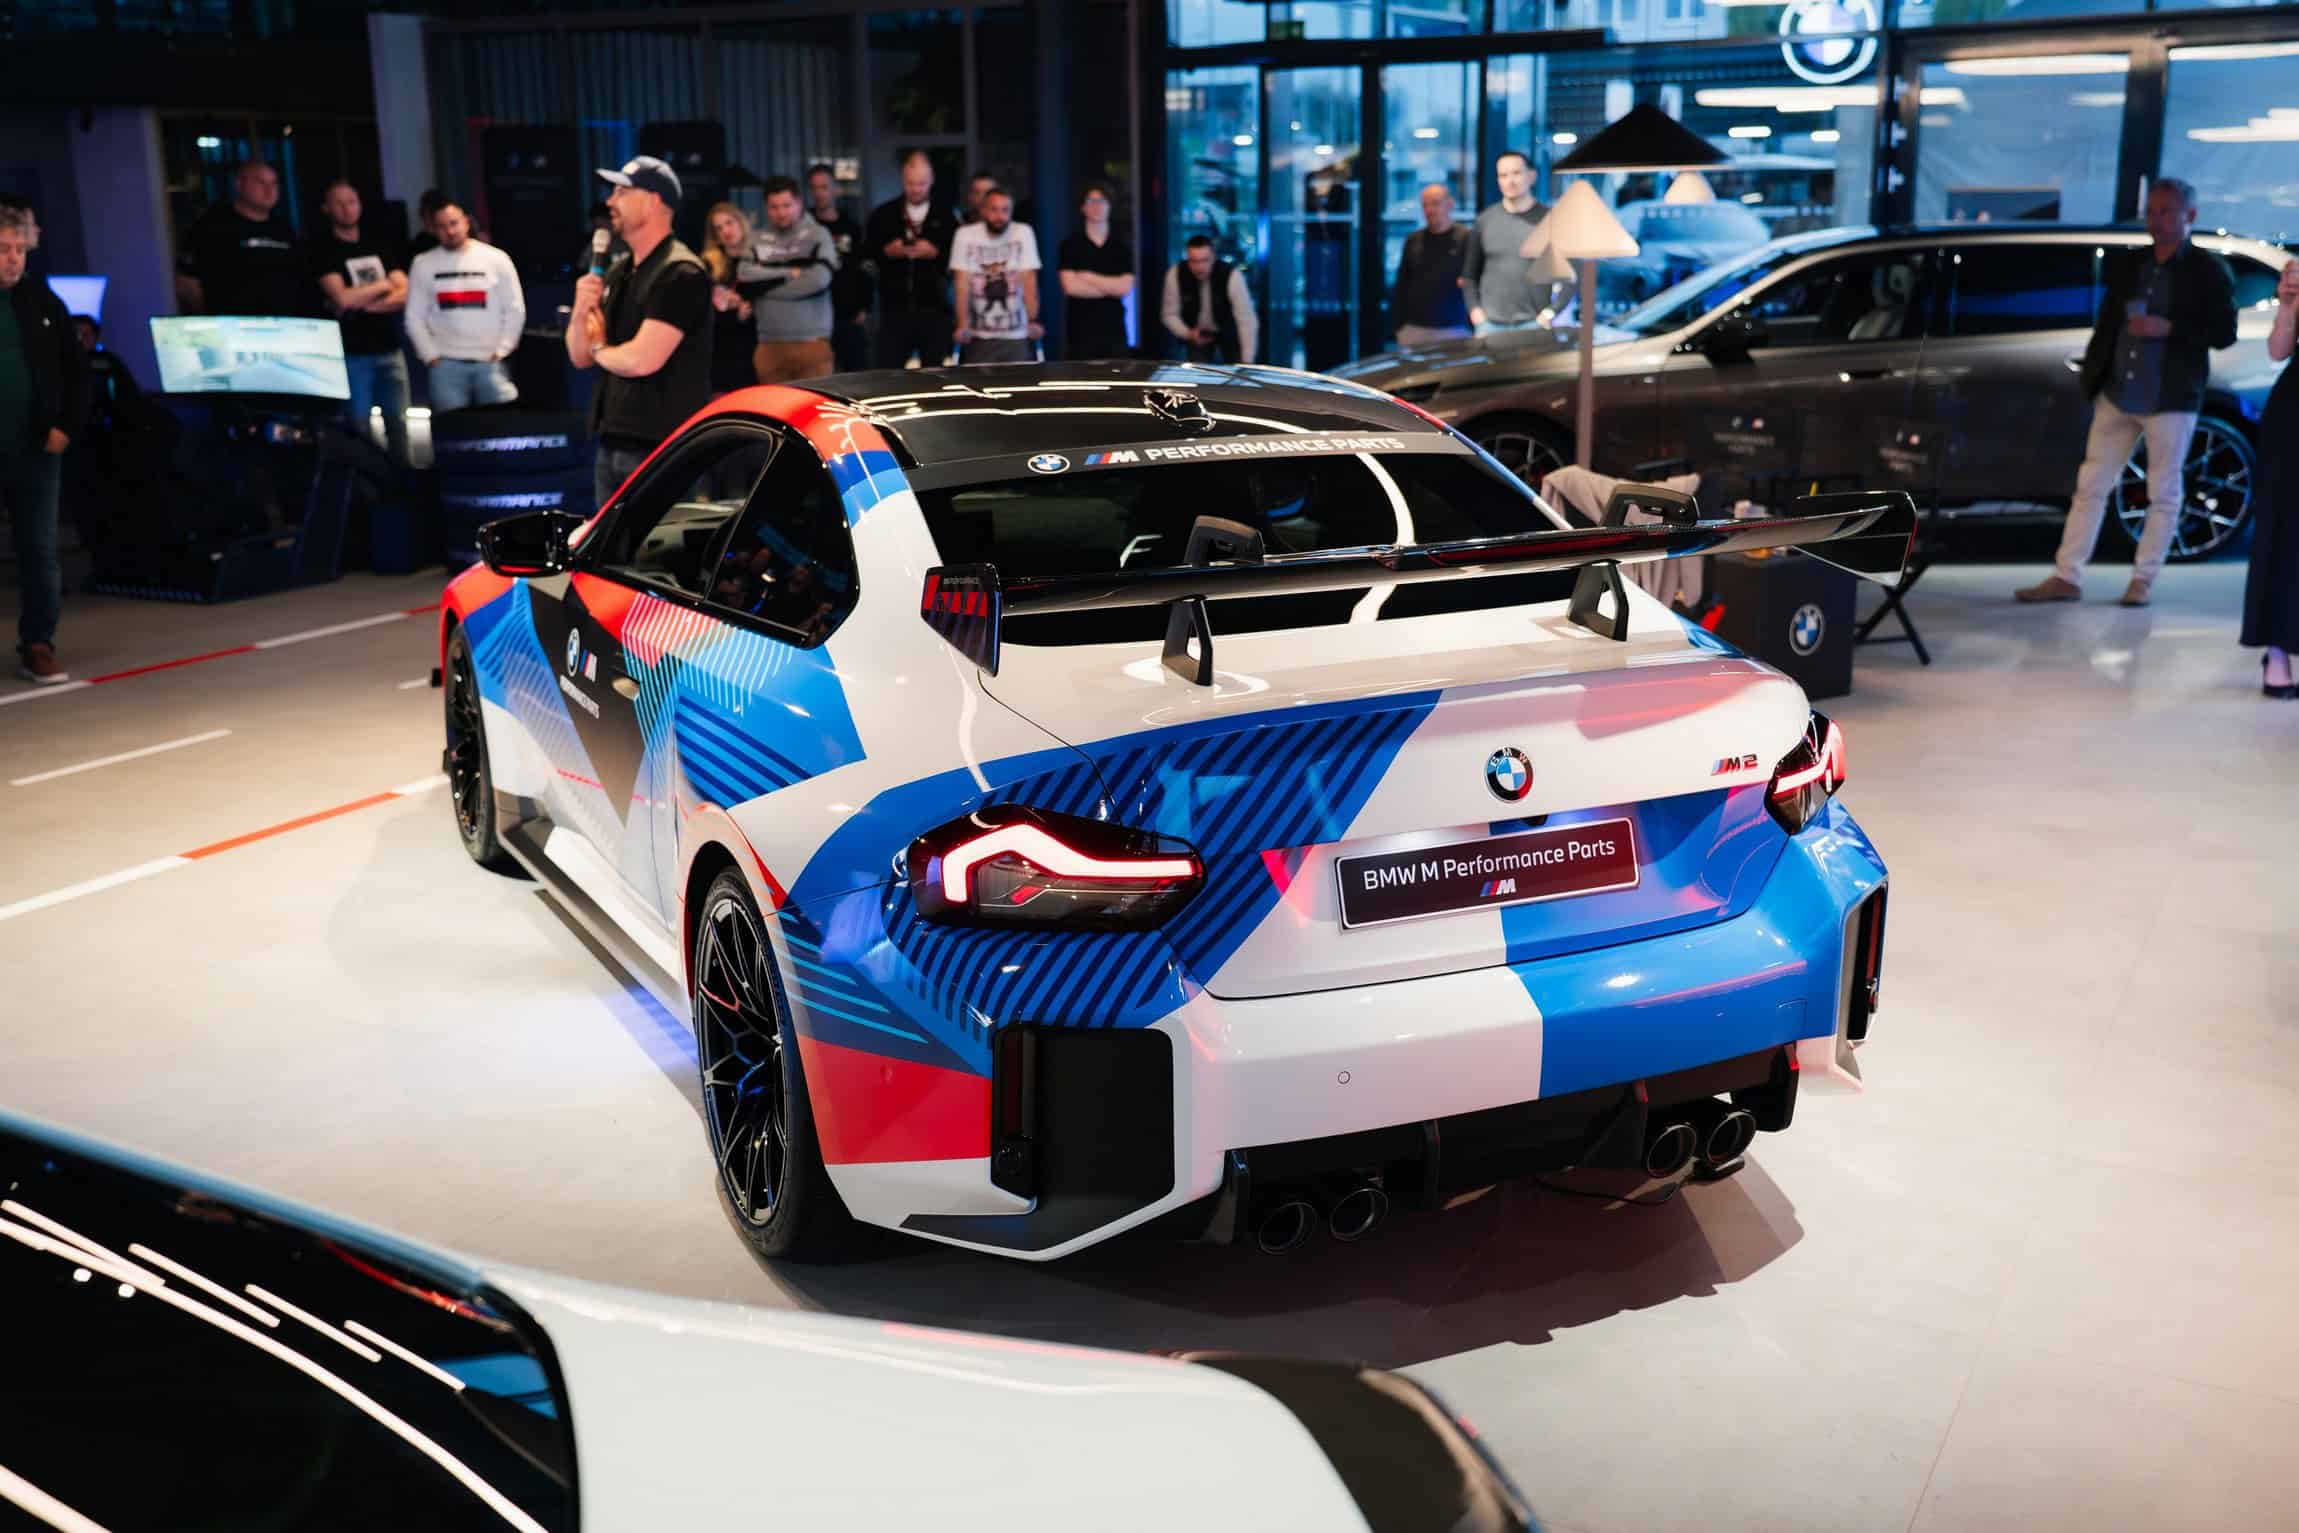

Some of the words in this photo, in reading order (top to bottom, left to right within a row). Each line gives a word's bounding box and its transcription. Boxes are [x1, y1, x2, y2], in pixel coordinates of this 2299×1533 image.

[1144, 438, 1330, 461] PERFORMANCE
[1331, 437, 1405, 450] PARTS
[1727, 753, 1758, 771] M2
[1363, 863, 1416, 890] BMW
[1421, 860, 1439, 882] M
[1443, 847, 1565, 878] Performance
[1567, 839, 1616, 860] Parts
